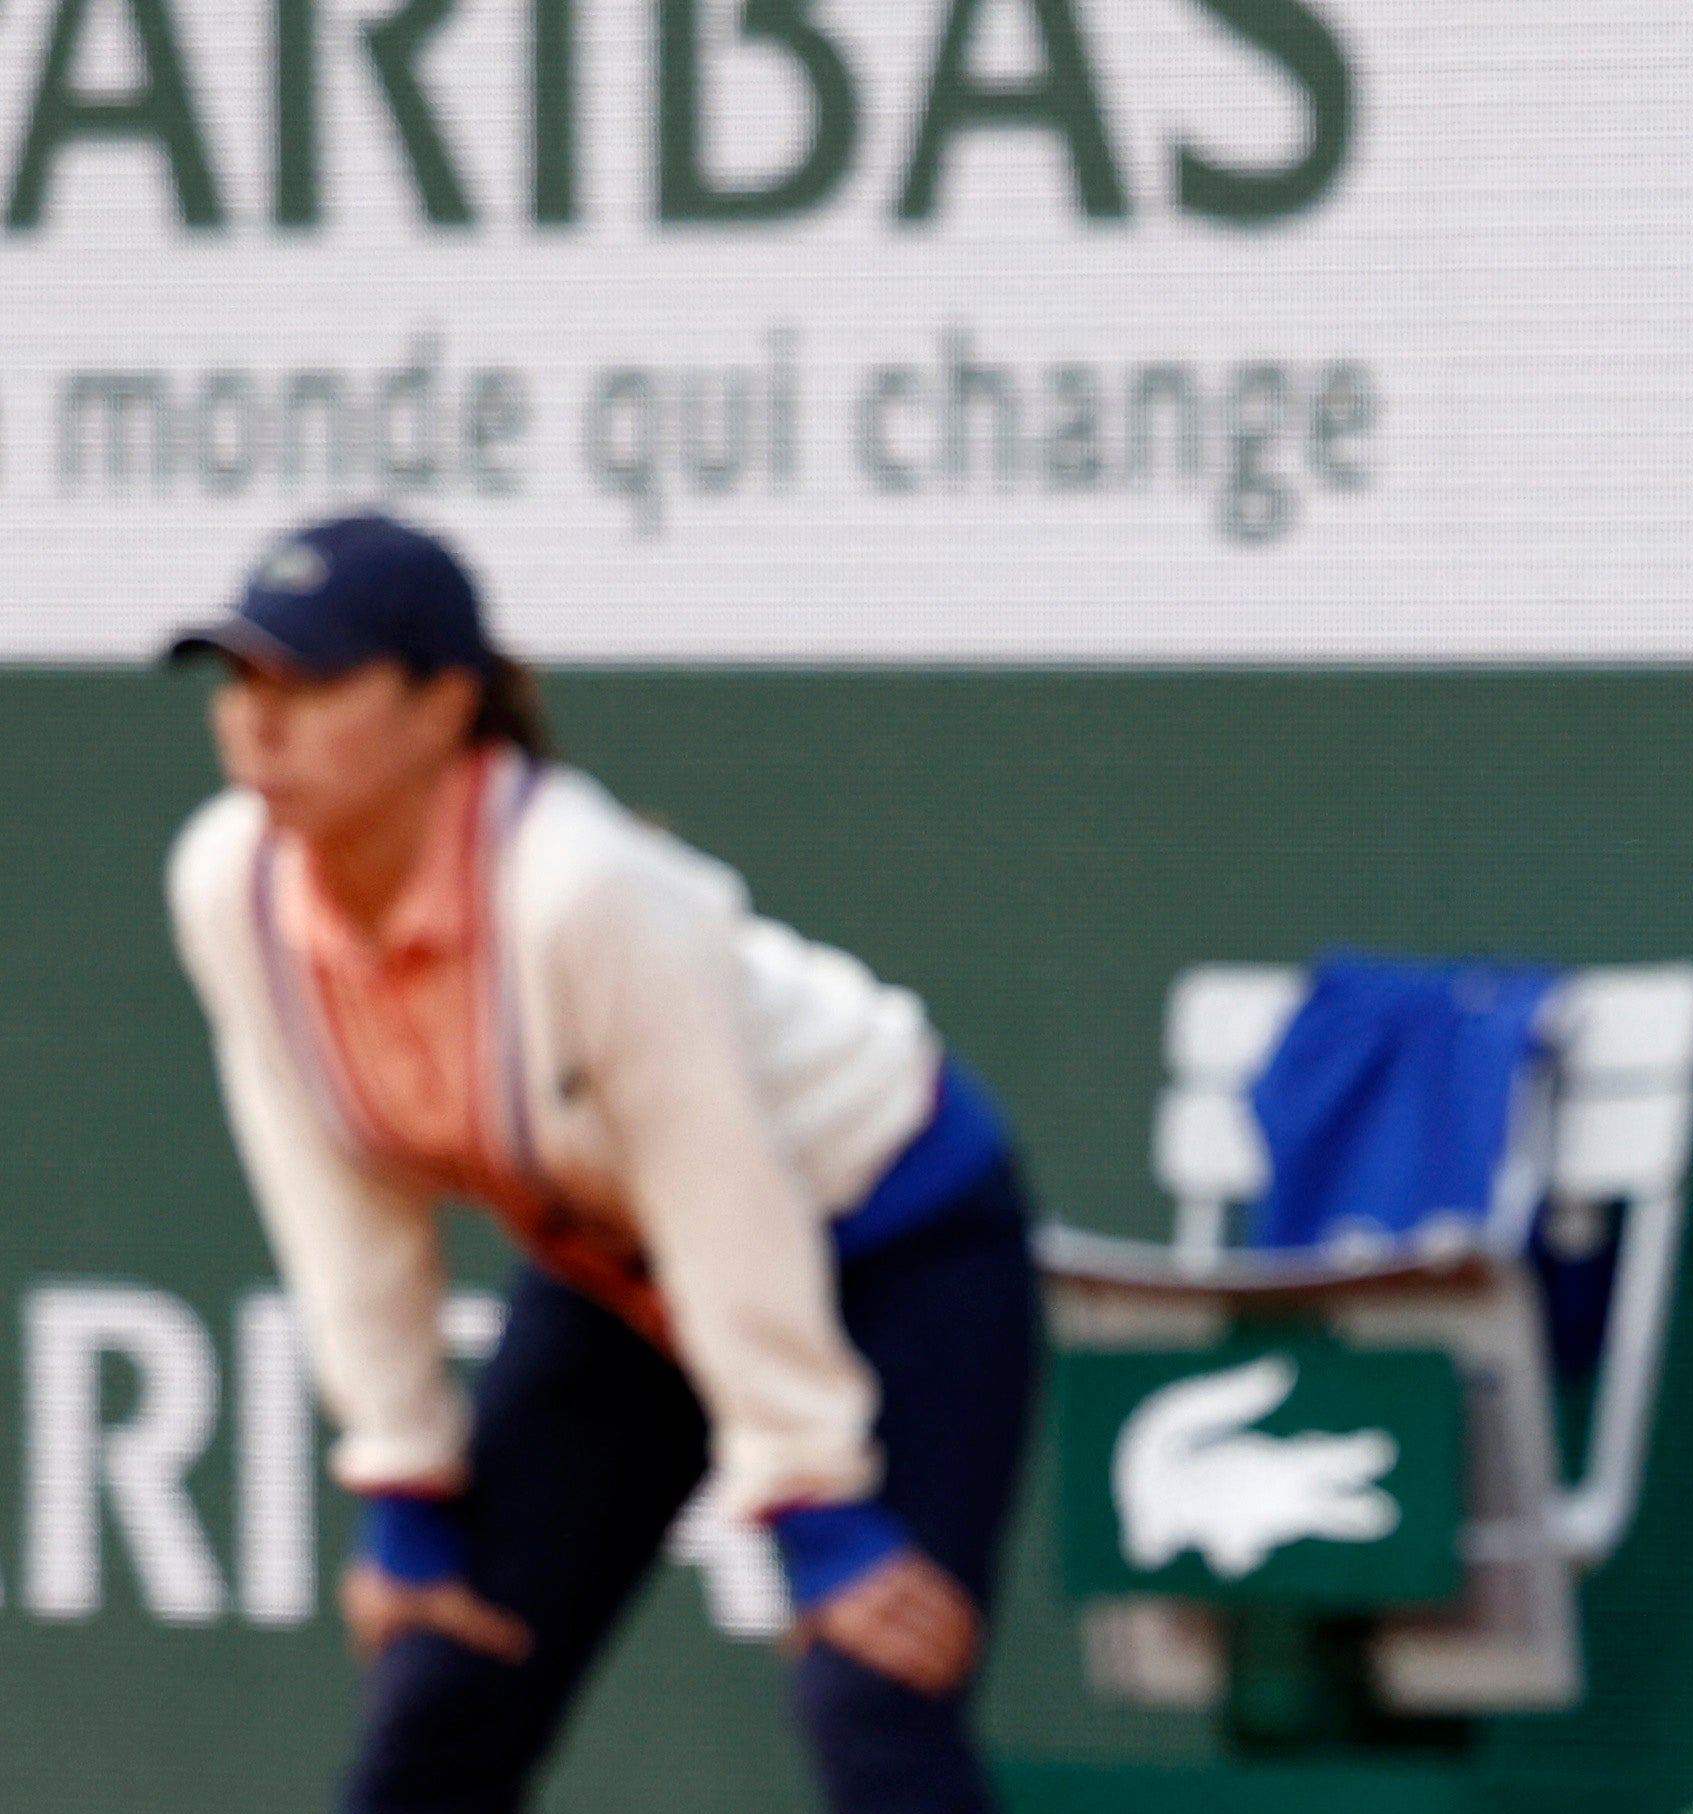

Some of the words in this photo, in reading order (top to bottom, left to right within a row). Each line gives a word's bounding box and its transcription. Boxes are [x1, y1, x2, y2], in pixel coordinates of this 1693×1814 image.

[52, 320, 528, 498] monde
[584, 322, 802, 540] qui
[856, 320, 1384, 545] change
